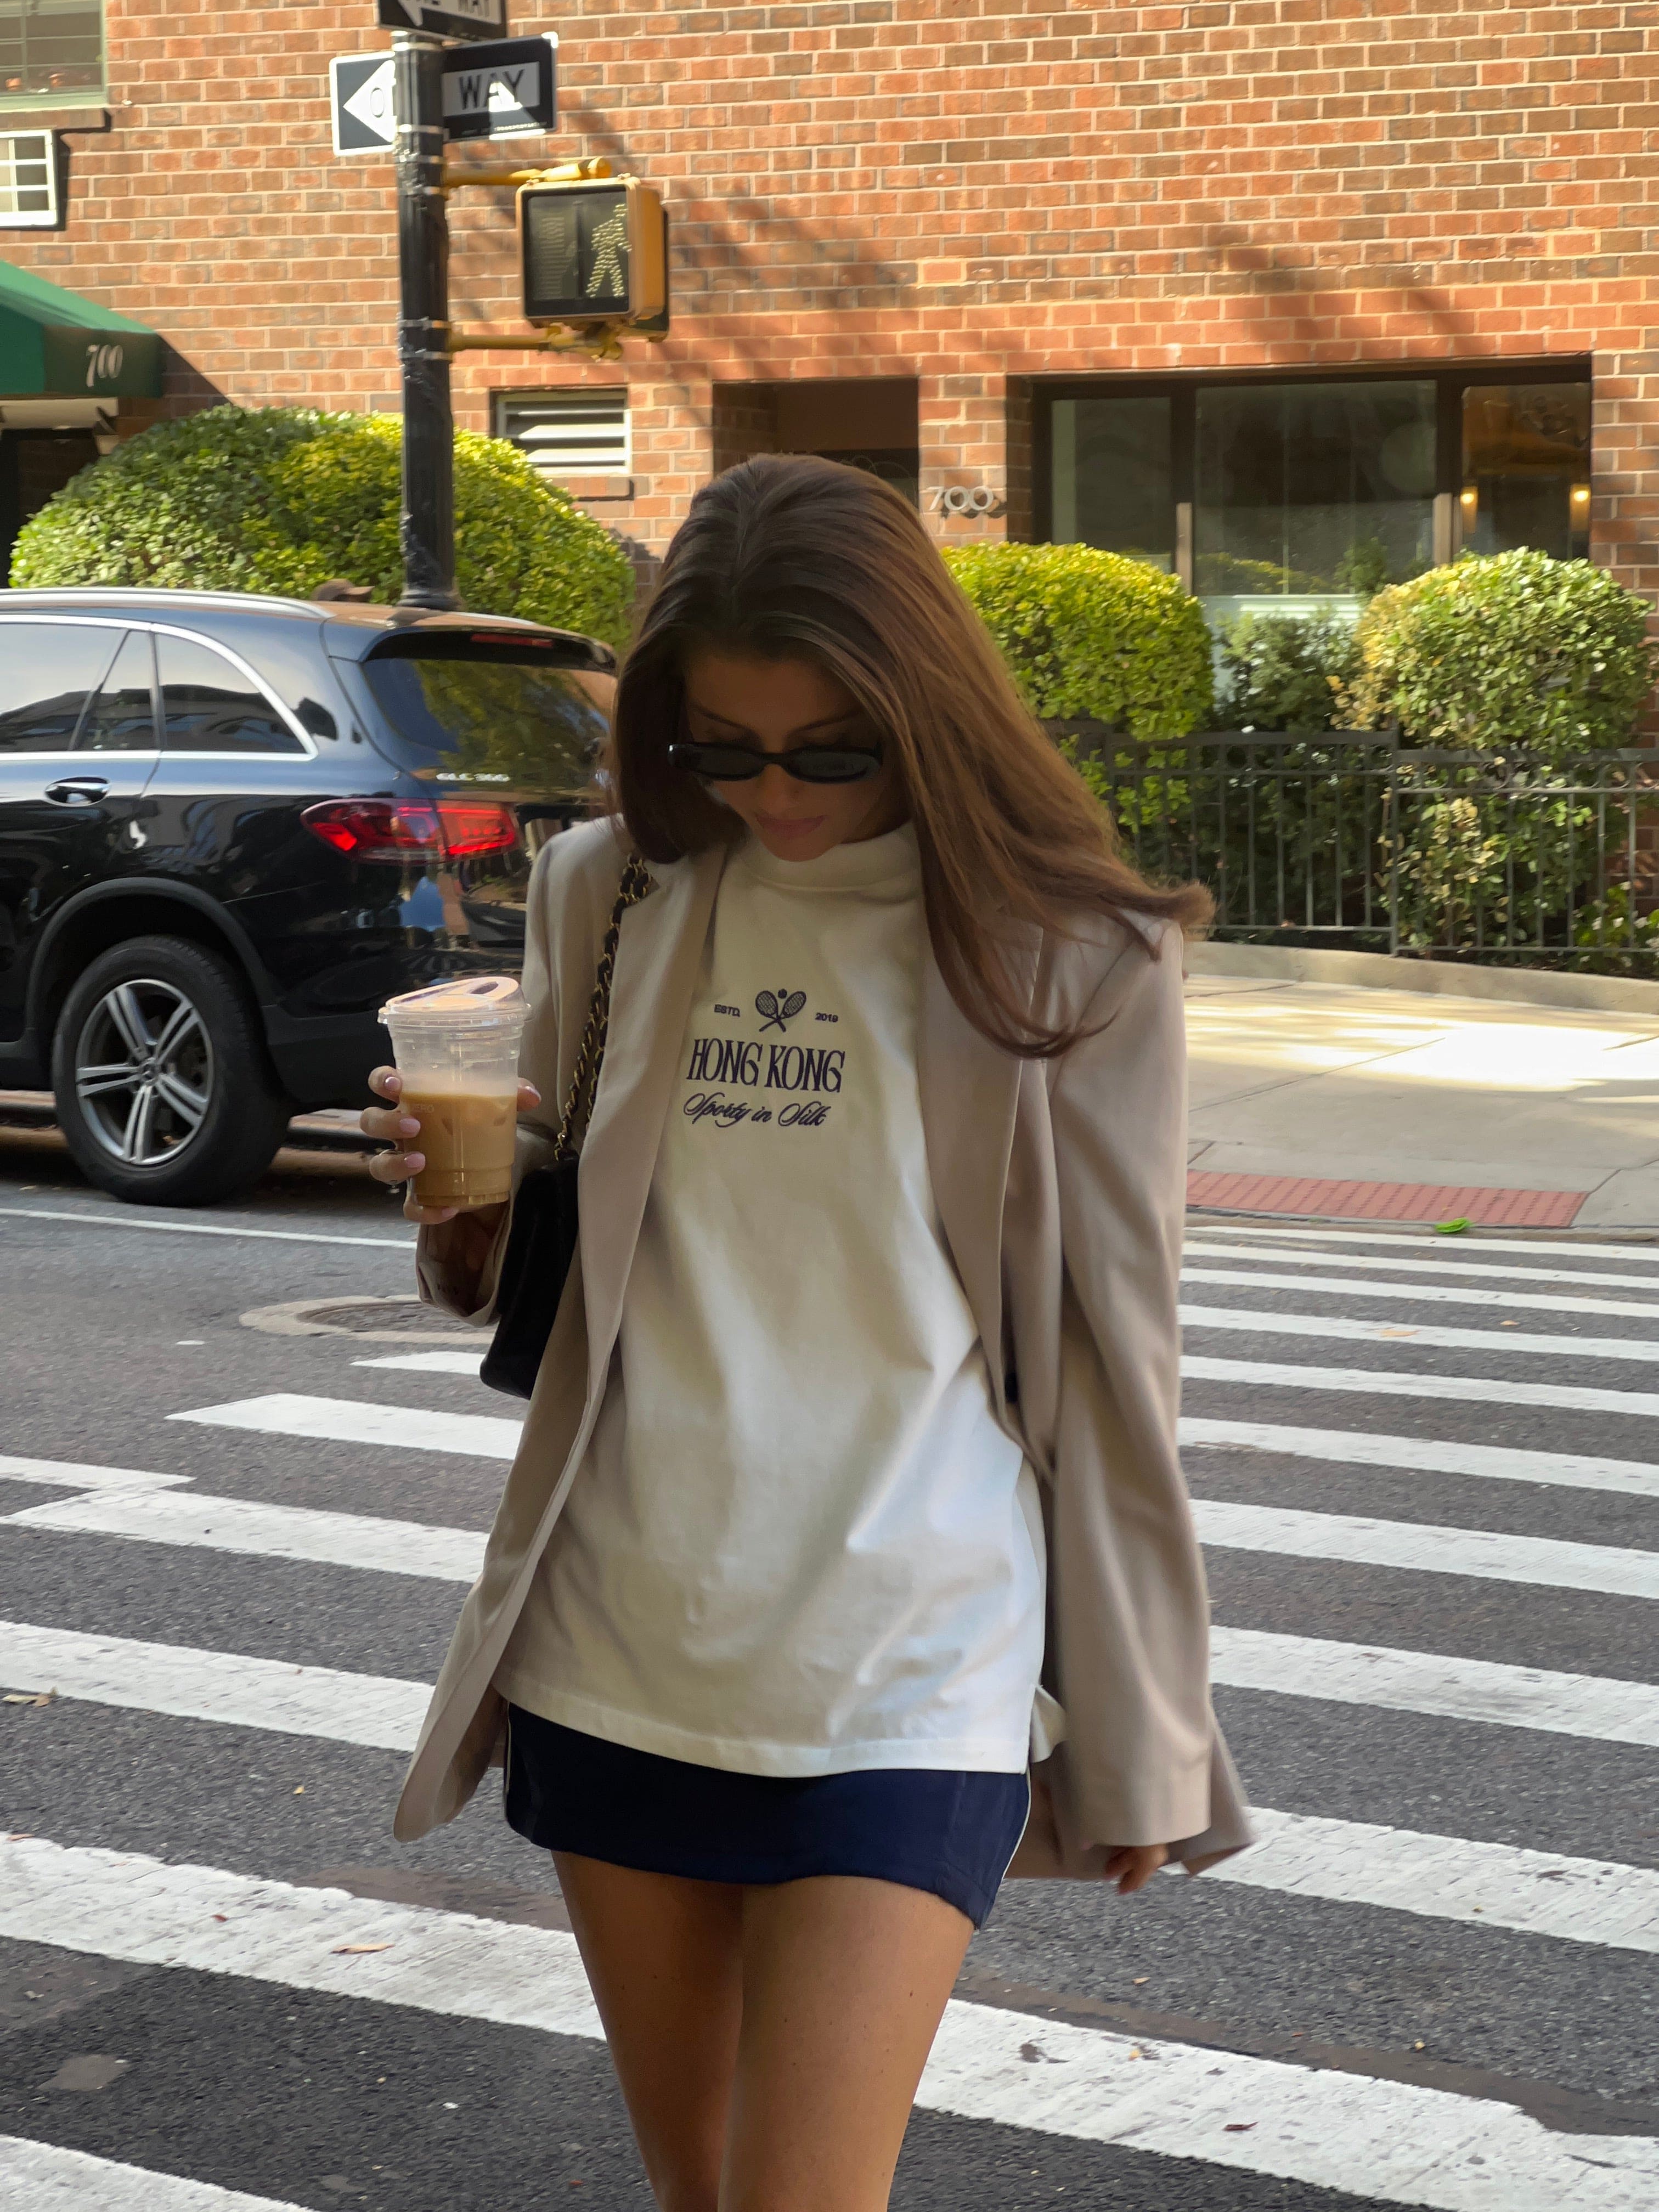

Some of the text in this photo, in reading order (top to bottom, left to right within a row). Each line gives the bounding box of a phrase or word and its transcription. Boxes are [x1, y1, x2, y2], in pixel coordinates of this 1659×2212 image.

[459, 69, 526, 110] WAY
[86, 345, 123, 387] 700
[927, 486, 994, 511] 700
[686, 1038, 845, 1093] HONG KONG
[684, 1092, 831, 1128] Sporty in Silk
